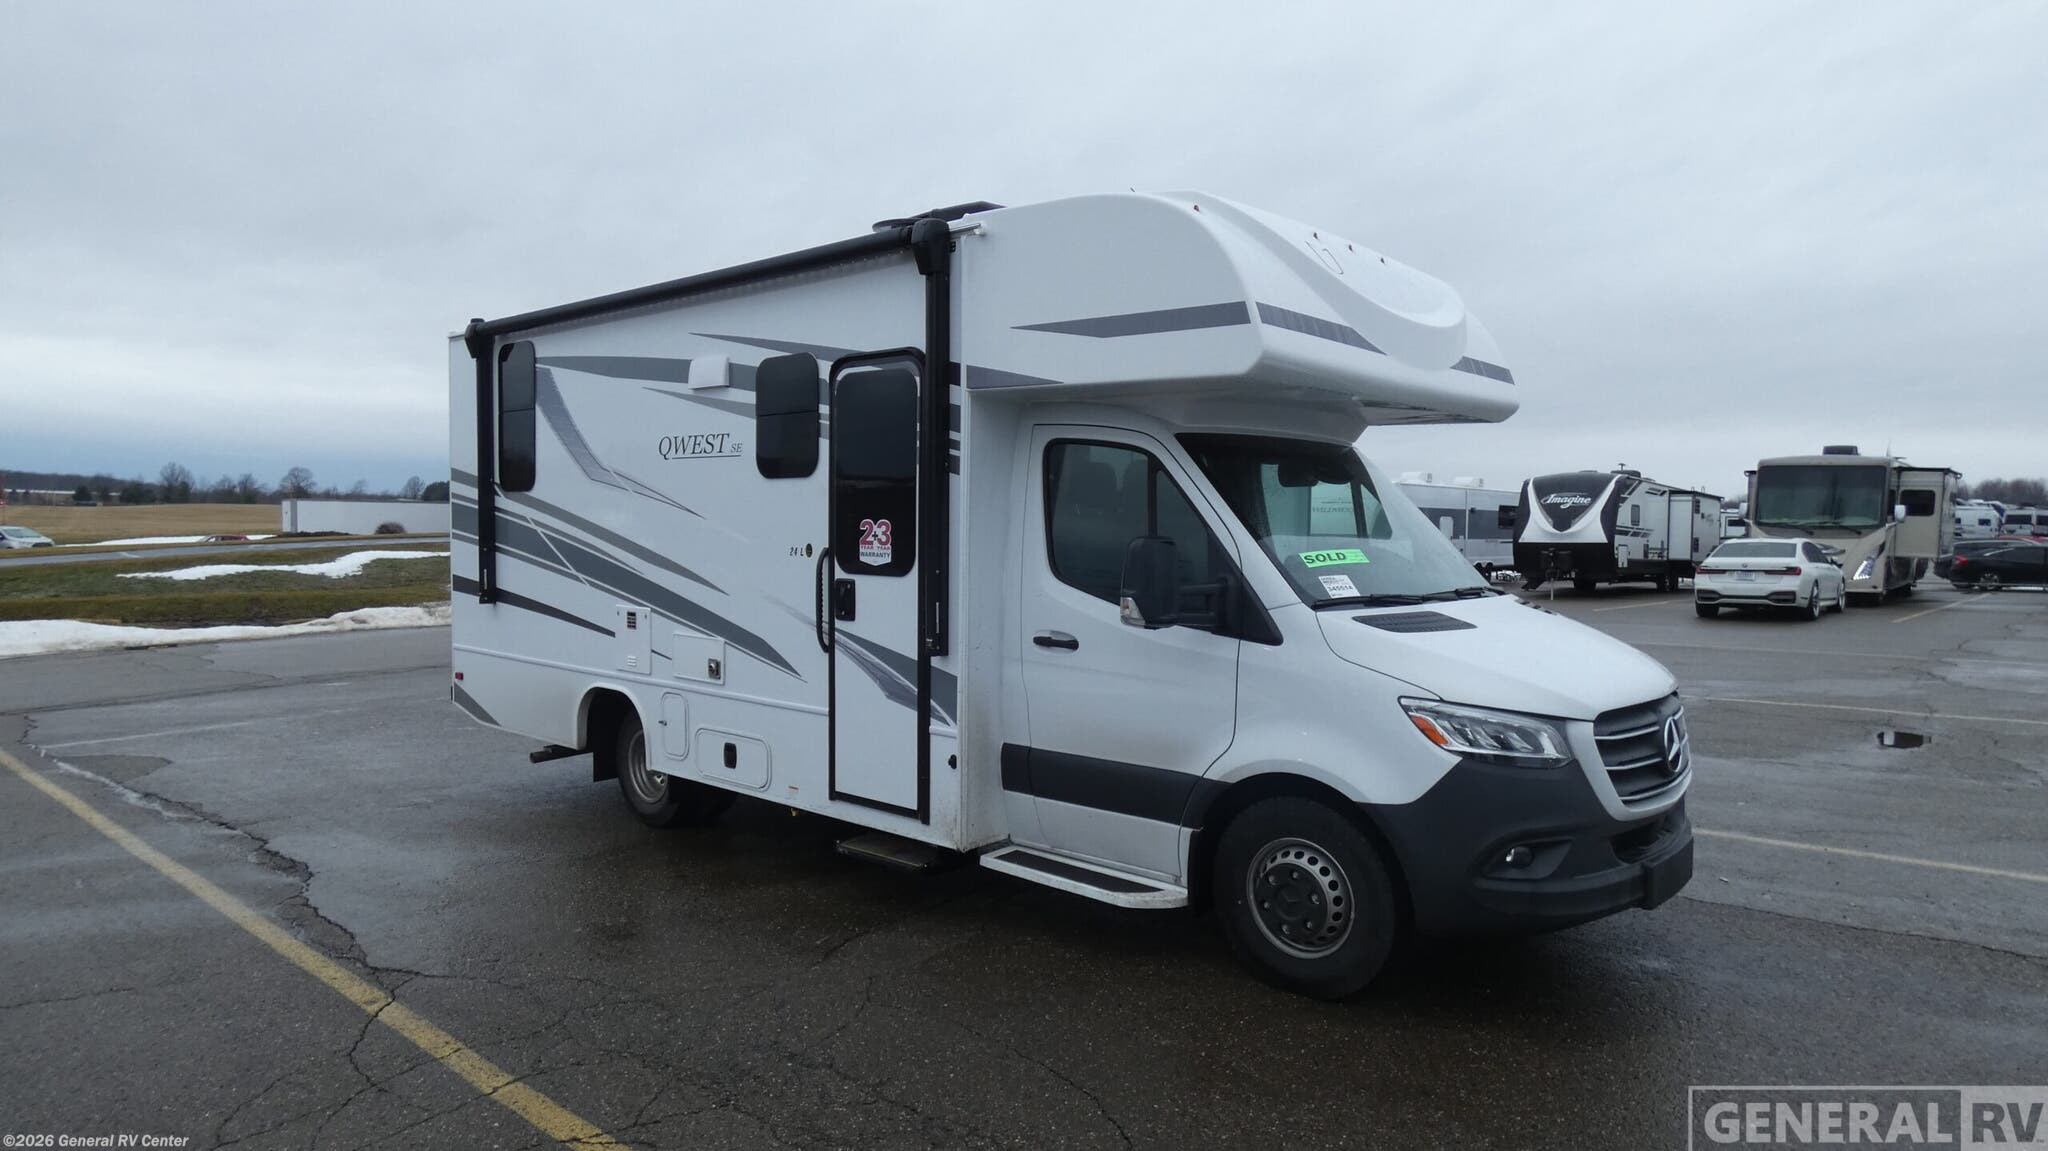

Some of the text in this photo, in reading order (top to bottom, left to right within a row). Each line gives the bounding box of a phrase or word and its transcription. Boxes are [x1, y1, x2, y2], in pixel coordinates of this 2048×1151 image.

[658, 433, 743, 460] QWEST SE
[1541, 493, 1592, 509] Imagine
[1303, 552, 1346, 564] SOLD
